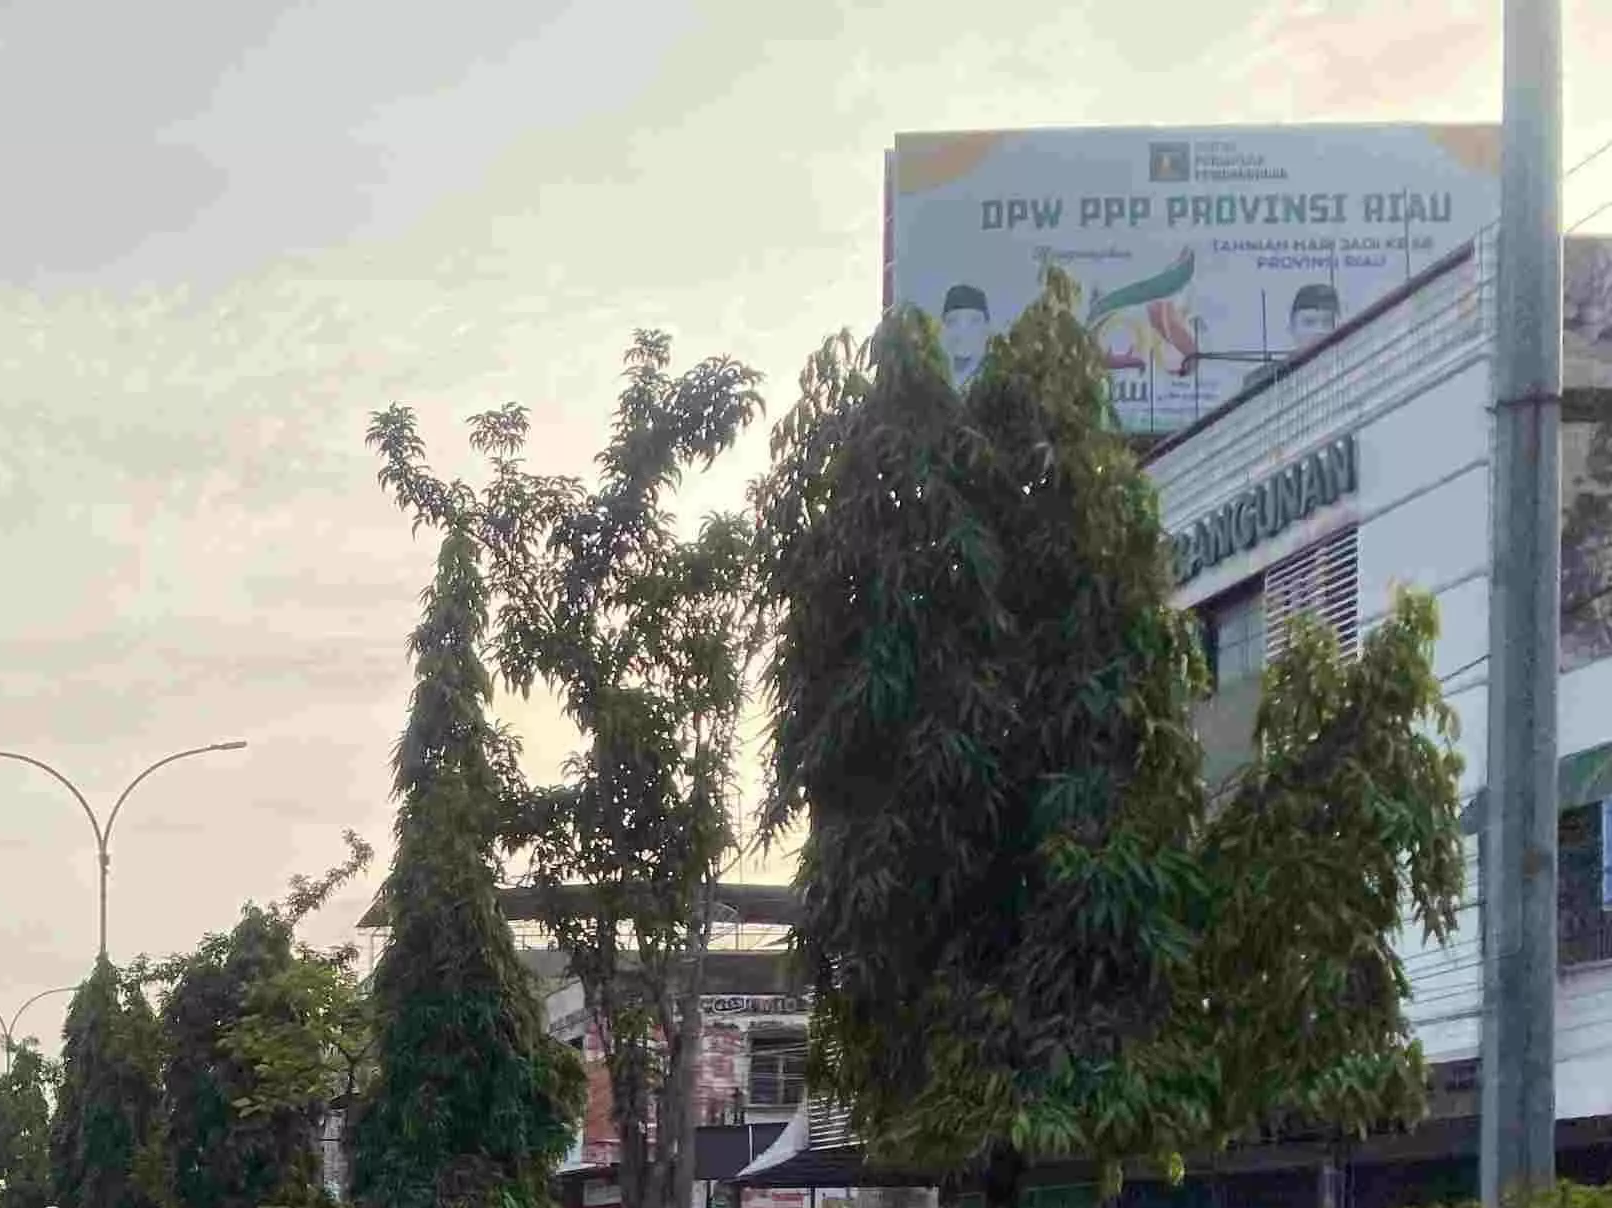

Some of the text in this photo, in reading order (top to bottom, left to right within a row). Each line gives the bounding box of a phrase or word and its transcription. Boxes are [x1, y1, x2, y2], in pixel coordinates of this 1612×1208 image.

[981, 191, 1454, 230] DPW PPP PROVINSI RIAU
[1213, 238, 1288, 252] TAHNIAH
[1294, 237, 1335, 251] HARI
[1340, 238, 1381, 251] JADI
[1257, 254, 1387, 271] PROVINSI RIAU
